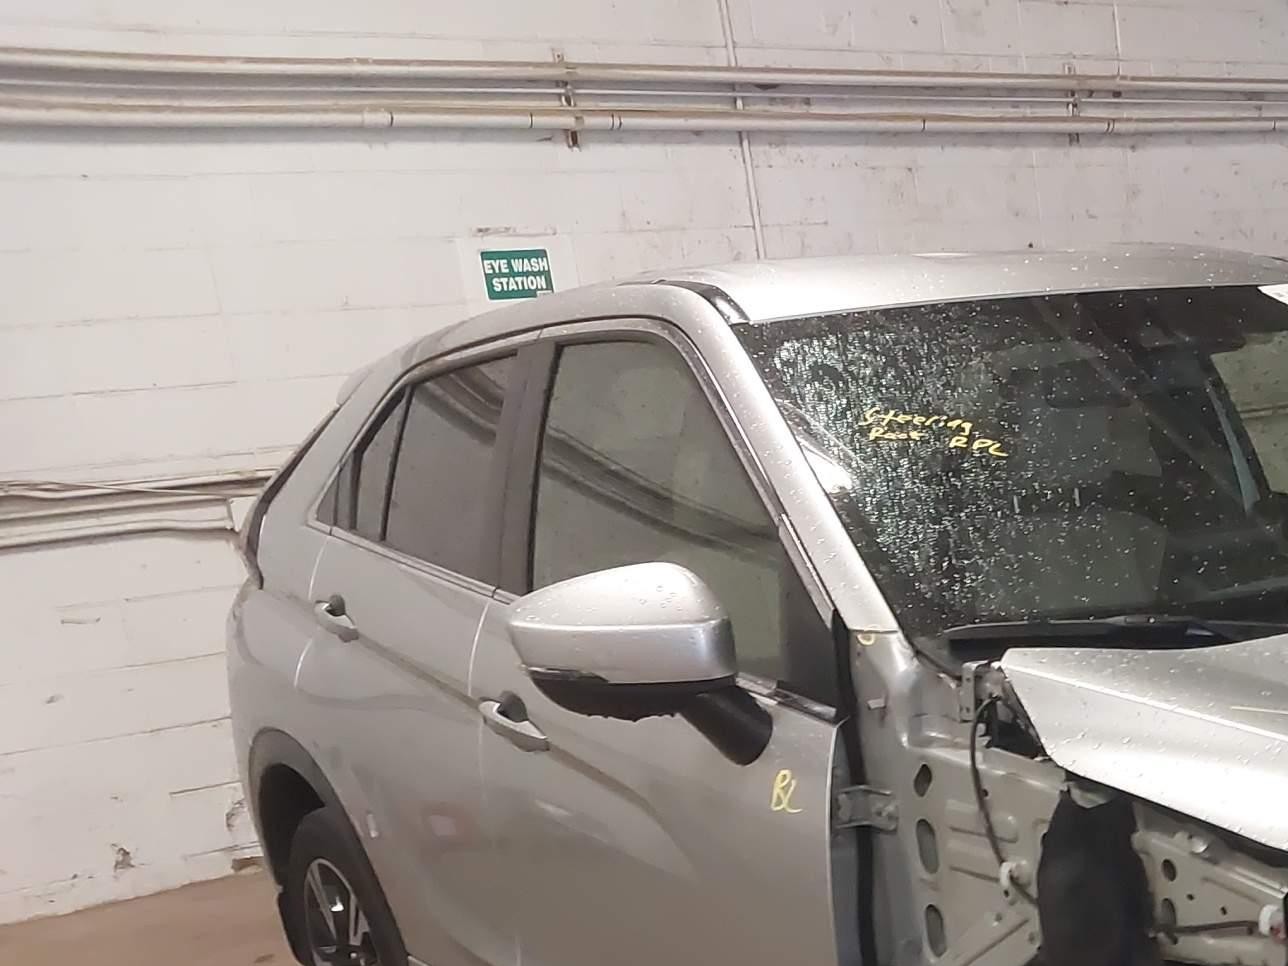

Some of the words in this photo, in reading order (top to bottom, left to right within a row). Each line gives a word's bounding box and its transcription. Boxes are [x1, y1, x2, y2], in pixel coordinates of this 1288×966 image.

[483, 259, 510, 274] EYE
[511, 257, 549, 273] WASH
[492, 275, 547, 292] STATION
